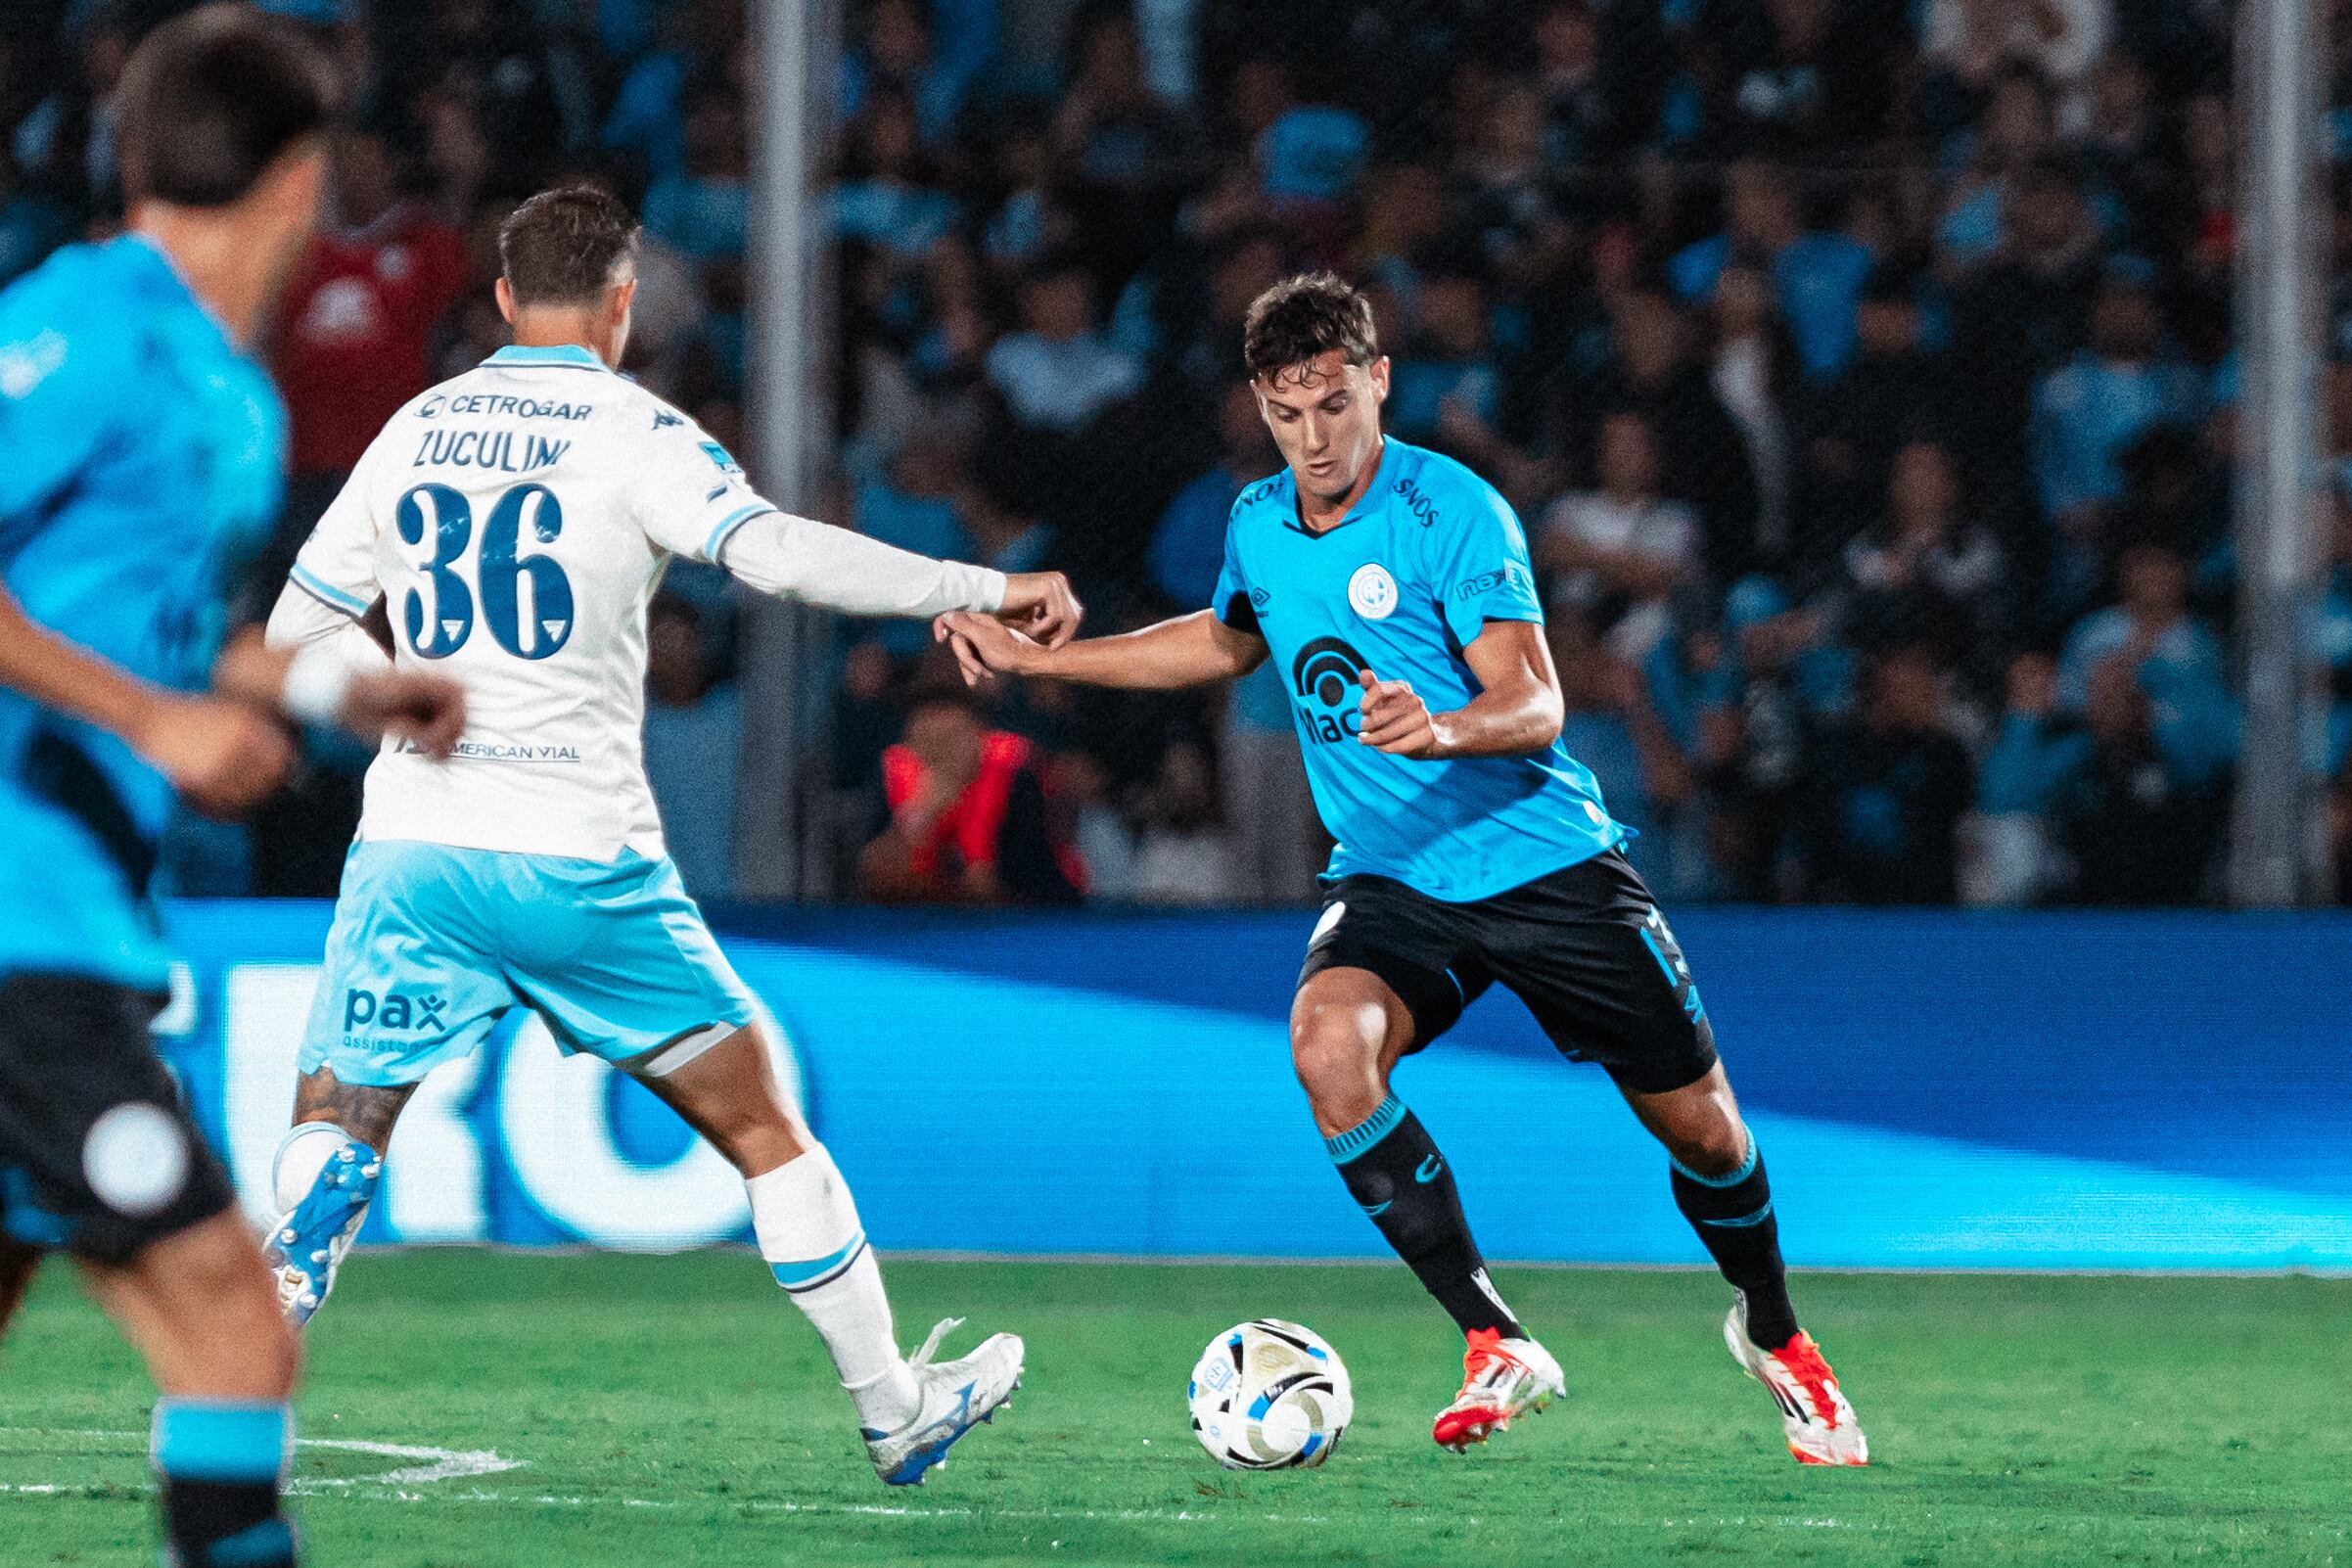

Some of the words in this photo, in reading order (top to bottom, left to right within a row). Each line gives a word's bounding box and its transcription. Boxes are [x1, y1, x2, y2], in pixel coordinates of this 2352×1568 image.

[451, 394, 592, 420] CETROGAR
[395, 483, 574, 660] 36
[450, 742, 532, 759] MERICAN
[537, 746, 580, 759] VIAL
[344, 988, 447, 1032] pax
